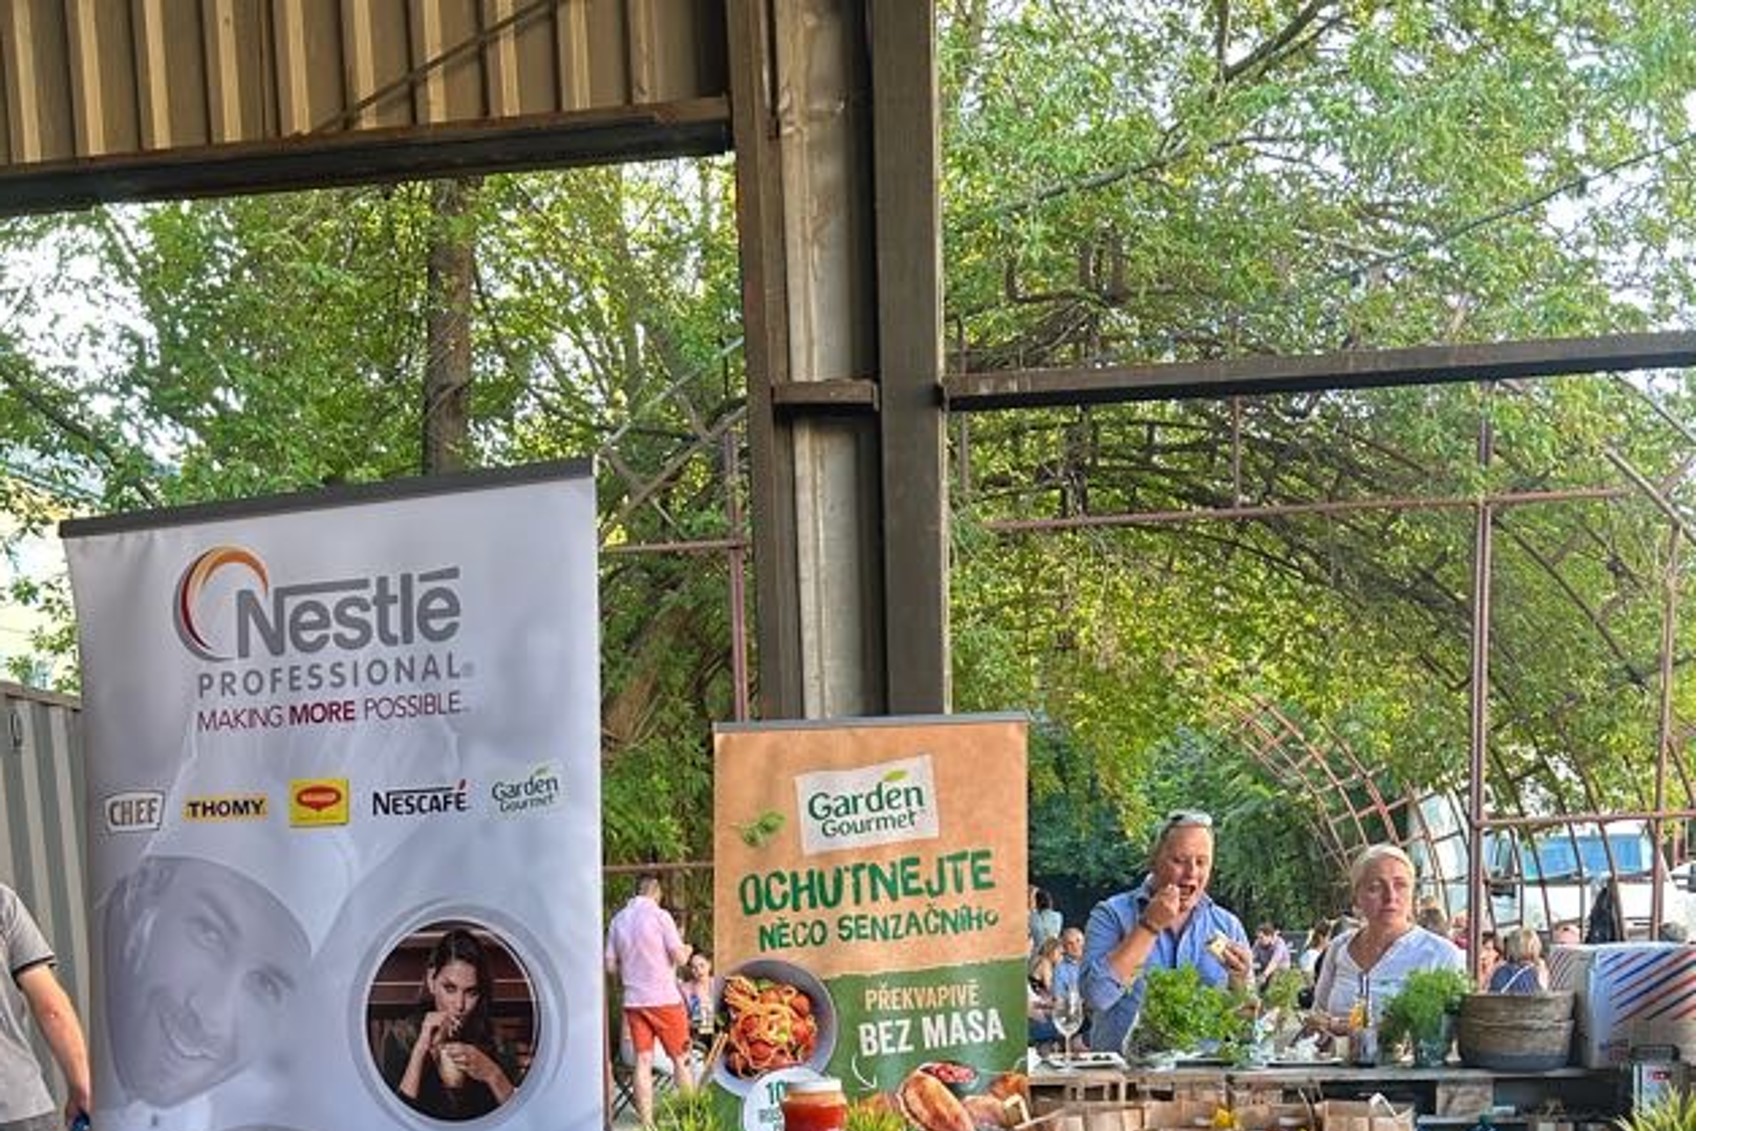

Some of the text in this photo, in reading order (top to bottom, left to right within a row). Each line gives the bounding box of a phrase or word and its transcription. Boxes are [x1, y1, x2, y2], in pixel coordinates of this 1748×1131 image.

[237, 567, 461, 659] Nestlé
[198, 651, 461, 699] PROFESSIONAL
[197, 705, 284, 733] MAKING
[289, 701, 356, 726] MORE
[372, 779, 468, 816] NESCAFÉ
[492, 775, 559, 802] Garden
[807, 779, 924, 821] Garden
[108, 795, 158, 829] CHEF
[188, 797, 265, 819] THOMY
[822, 810, 919, 839] Gourmet
[738, 850, 996, 916] OCHUTNEJTE
[758, 913, 828, 952] NĚCO
[865, 979, 981, 1012] PŘEKVAPIVĚ
[859, 1008, 1006, 1057] BEZ MASA
